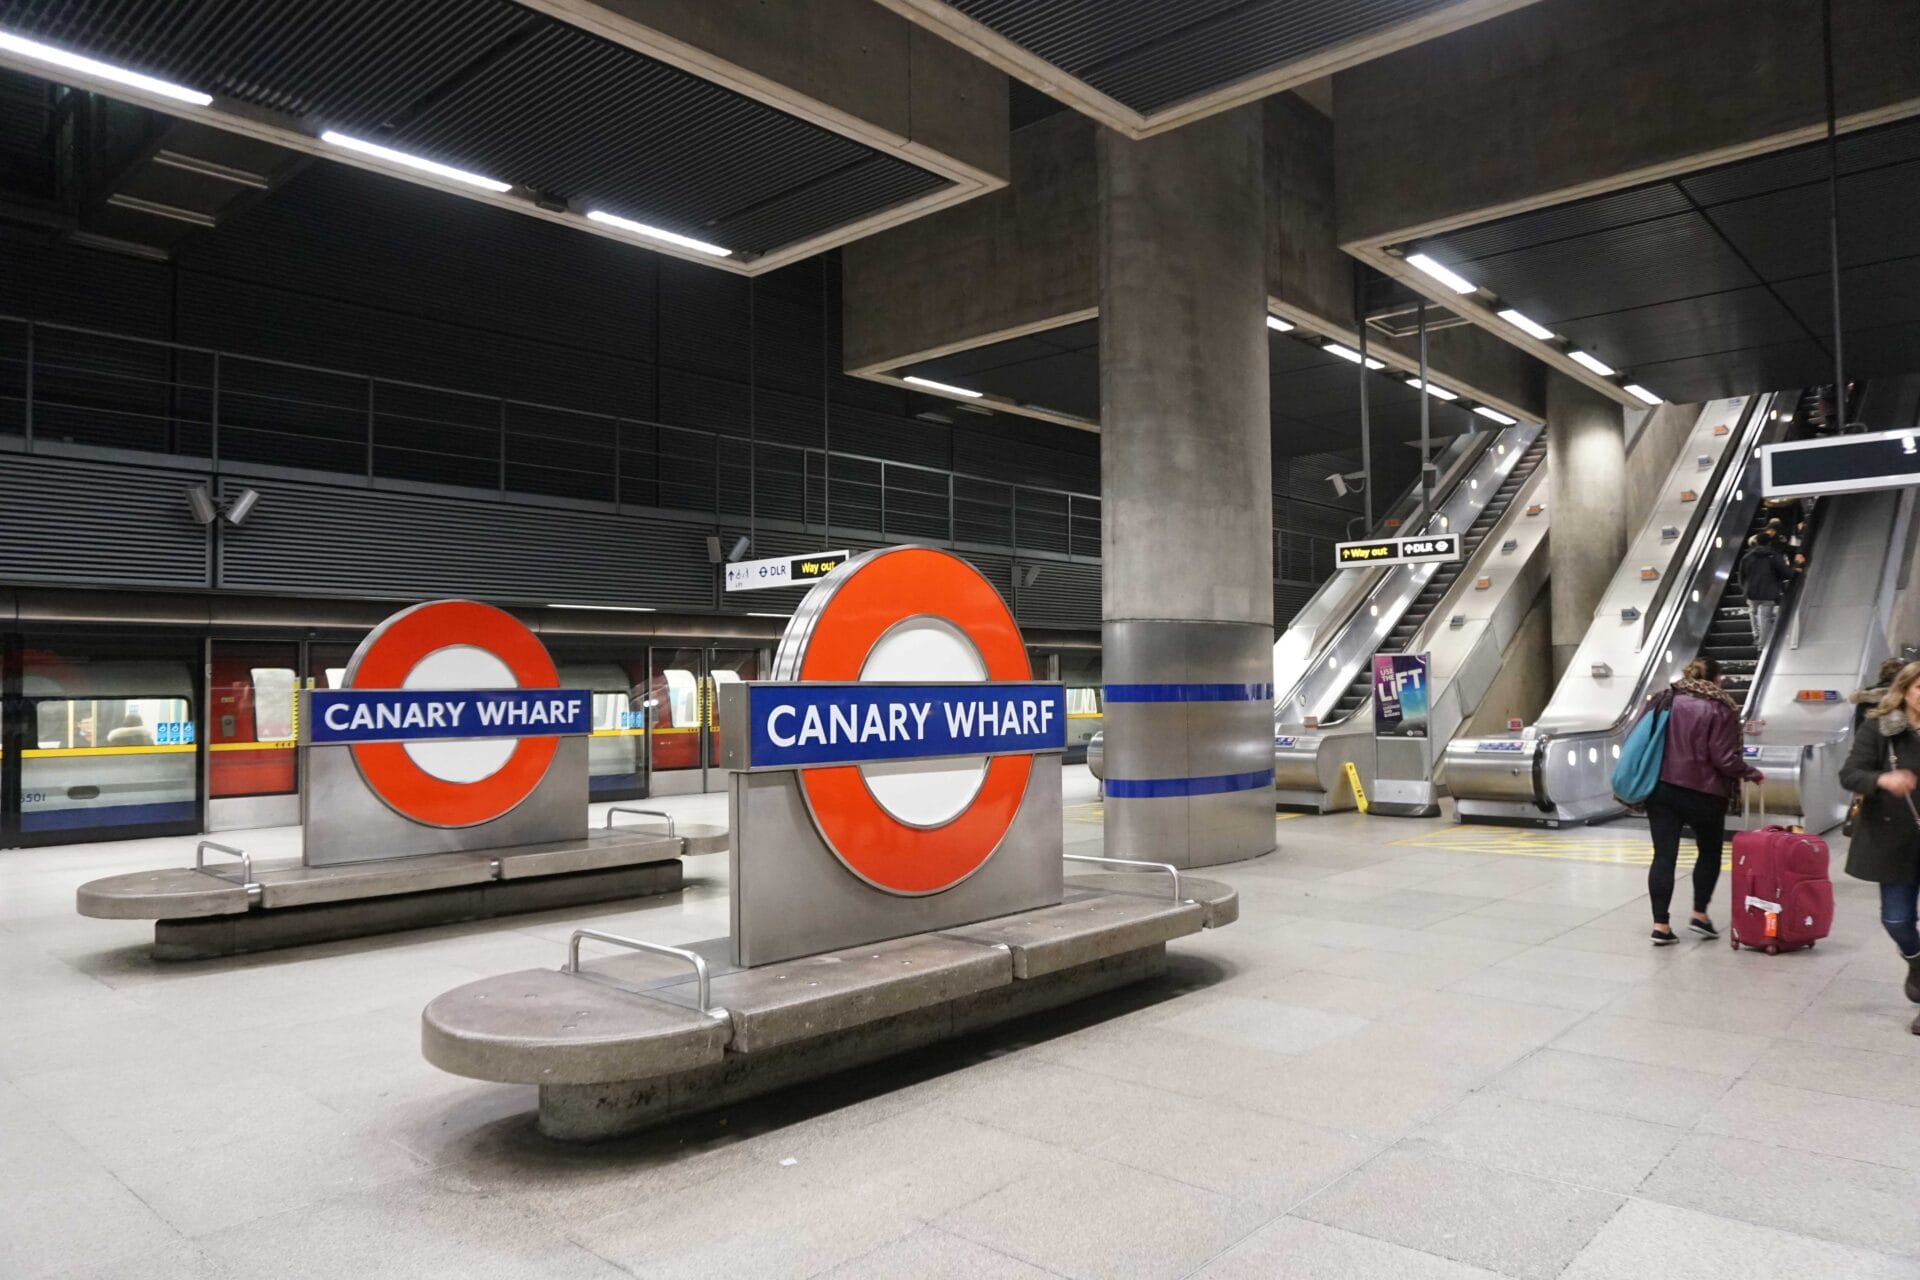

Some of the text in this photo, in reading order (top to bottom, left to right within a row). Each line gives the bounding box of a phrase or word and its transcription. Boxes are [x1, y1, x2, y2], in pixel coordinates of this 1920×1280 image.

[1351, 547, 1388, 558] Way out
[1413, 542, 1433, 553] DLR
[770, 566, 786, 576] DLR
[801, 561, 836, 574] Way out
[1378, 668, 1423, 702] LIFT
[324, 700, 581, 731] CANARY WHARF
[767, 700, 1055, 747] CANARY WHARF
